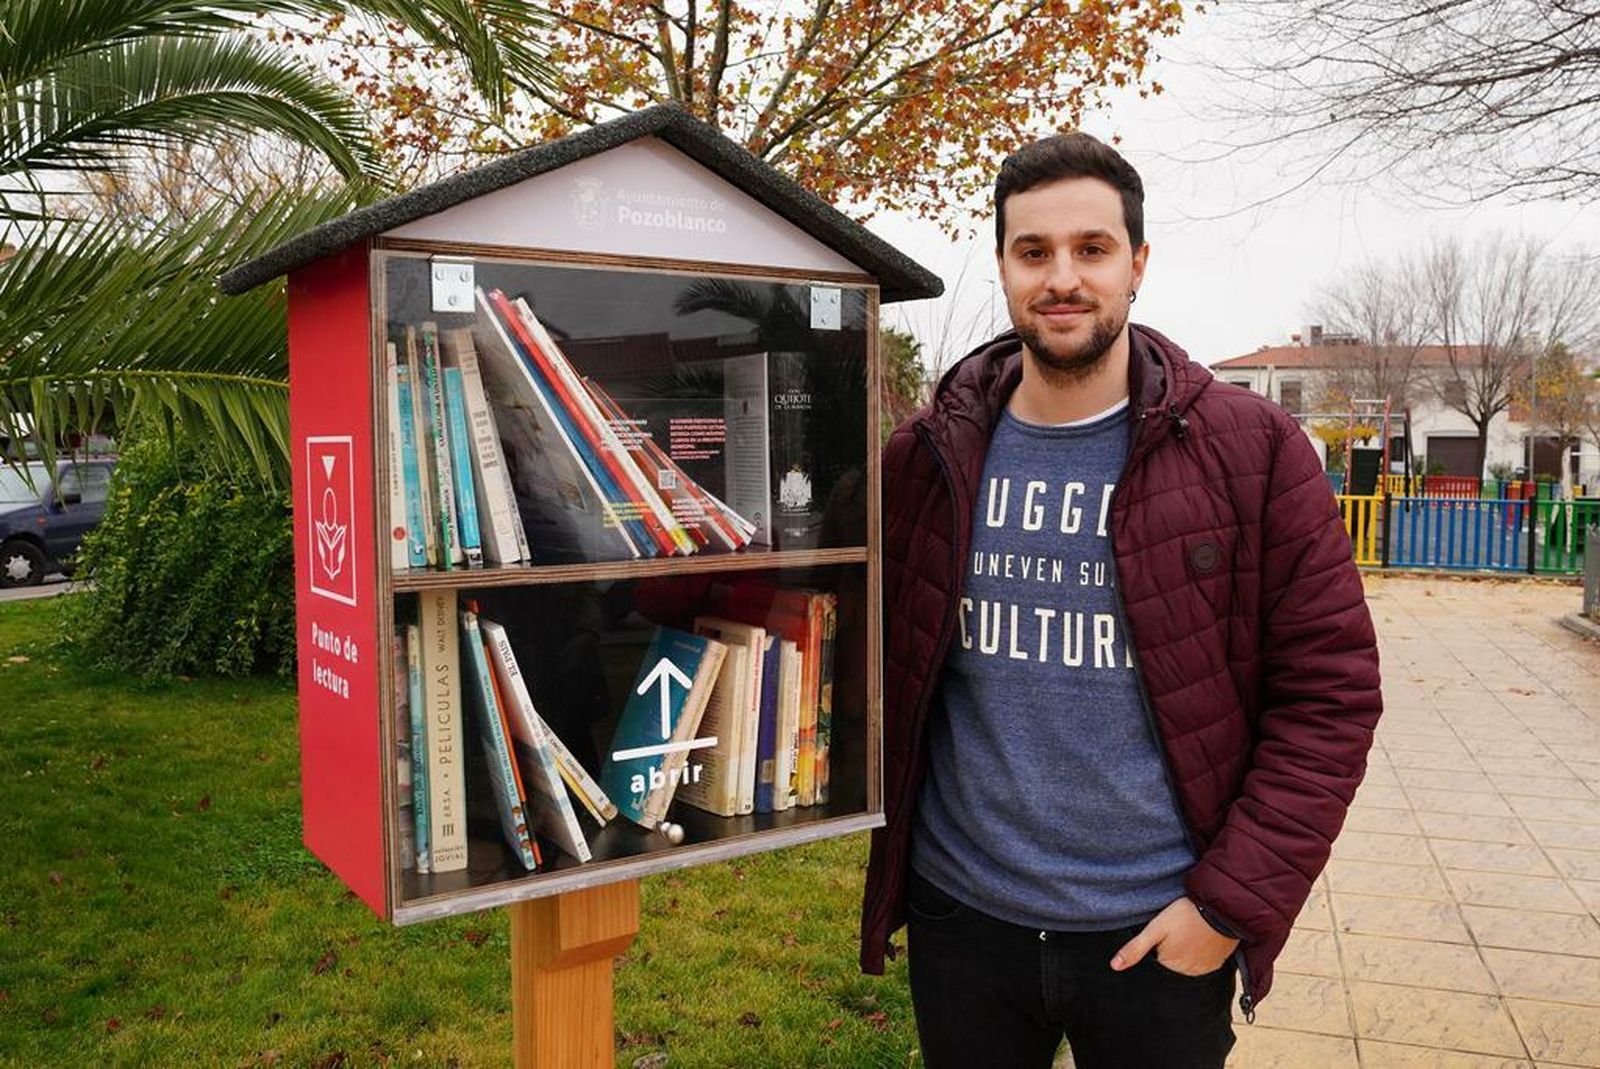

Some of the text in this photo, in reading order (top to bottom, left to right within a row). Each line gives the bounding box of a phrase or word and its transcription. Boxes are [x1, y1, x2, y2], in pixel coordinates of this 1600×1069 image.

[617, 189, 708, 212] Ayuntamiento
[618, 205, 727, 234] Pozoblanco
[973, 551, 1115, 588] UNEVEN SU
[311, 621, 358, 664] Punto de
[436, 629, 447, 653] WALT
[958, 597, 1135, 669] CULTUR
[312, 657, 350, 700] lectura
[436, 663, 451, 765] PELICULAS
[630, 761, 703, 794] abrir
